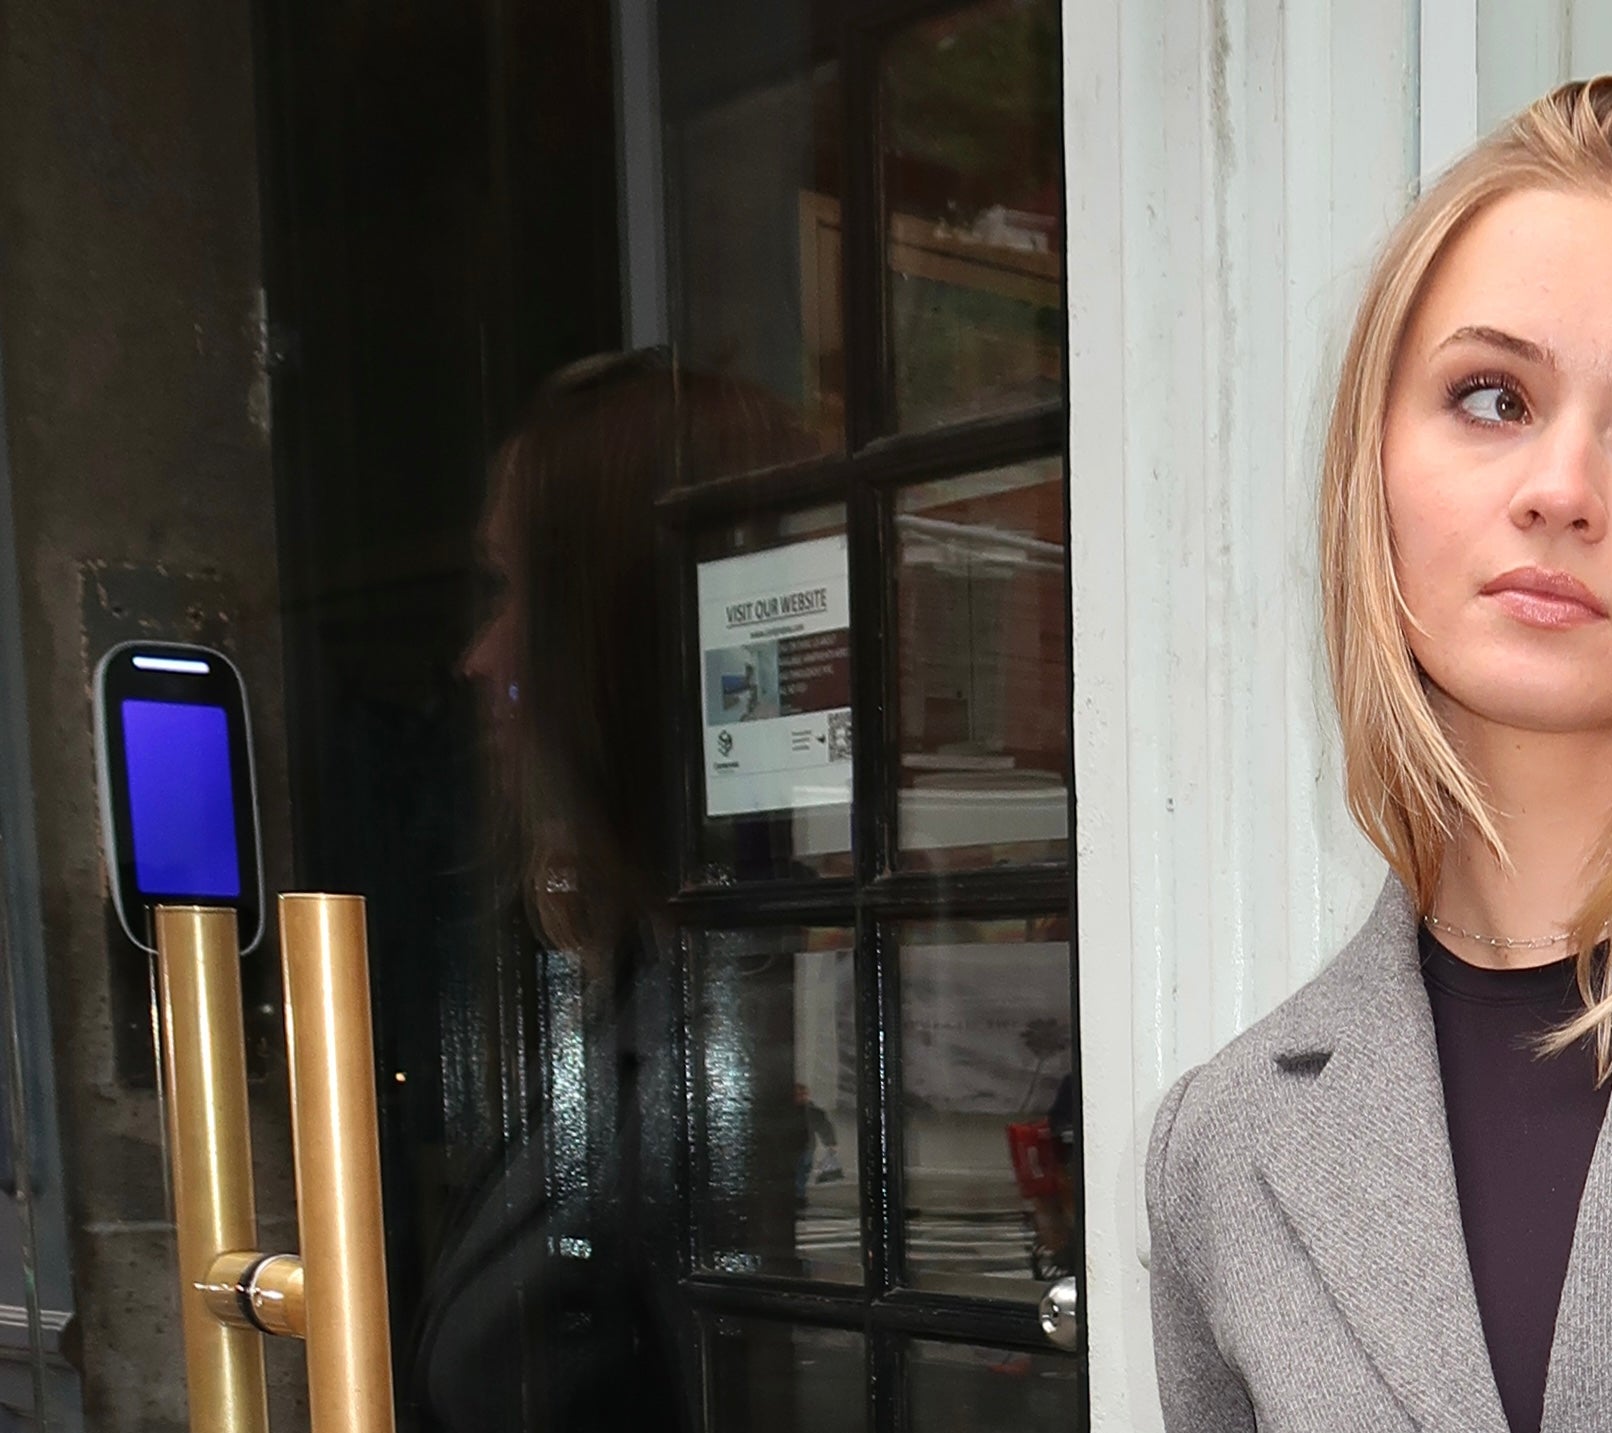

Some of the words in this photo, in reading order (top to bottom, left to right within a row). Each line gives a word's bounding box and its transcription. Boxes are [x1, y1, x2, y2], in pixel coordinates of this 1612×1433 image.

[726, 603, 753, 622] VISIT
[755, 598, 778, 619] OUR
[780, 587, 827, 613] WEBSITE
